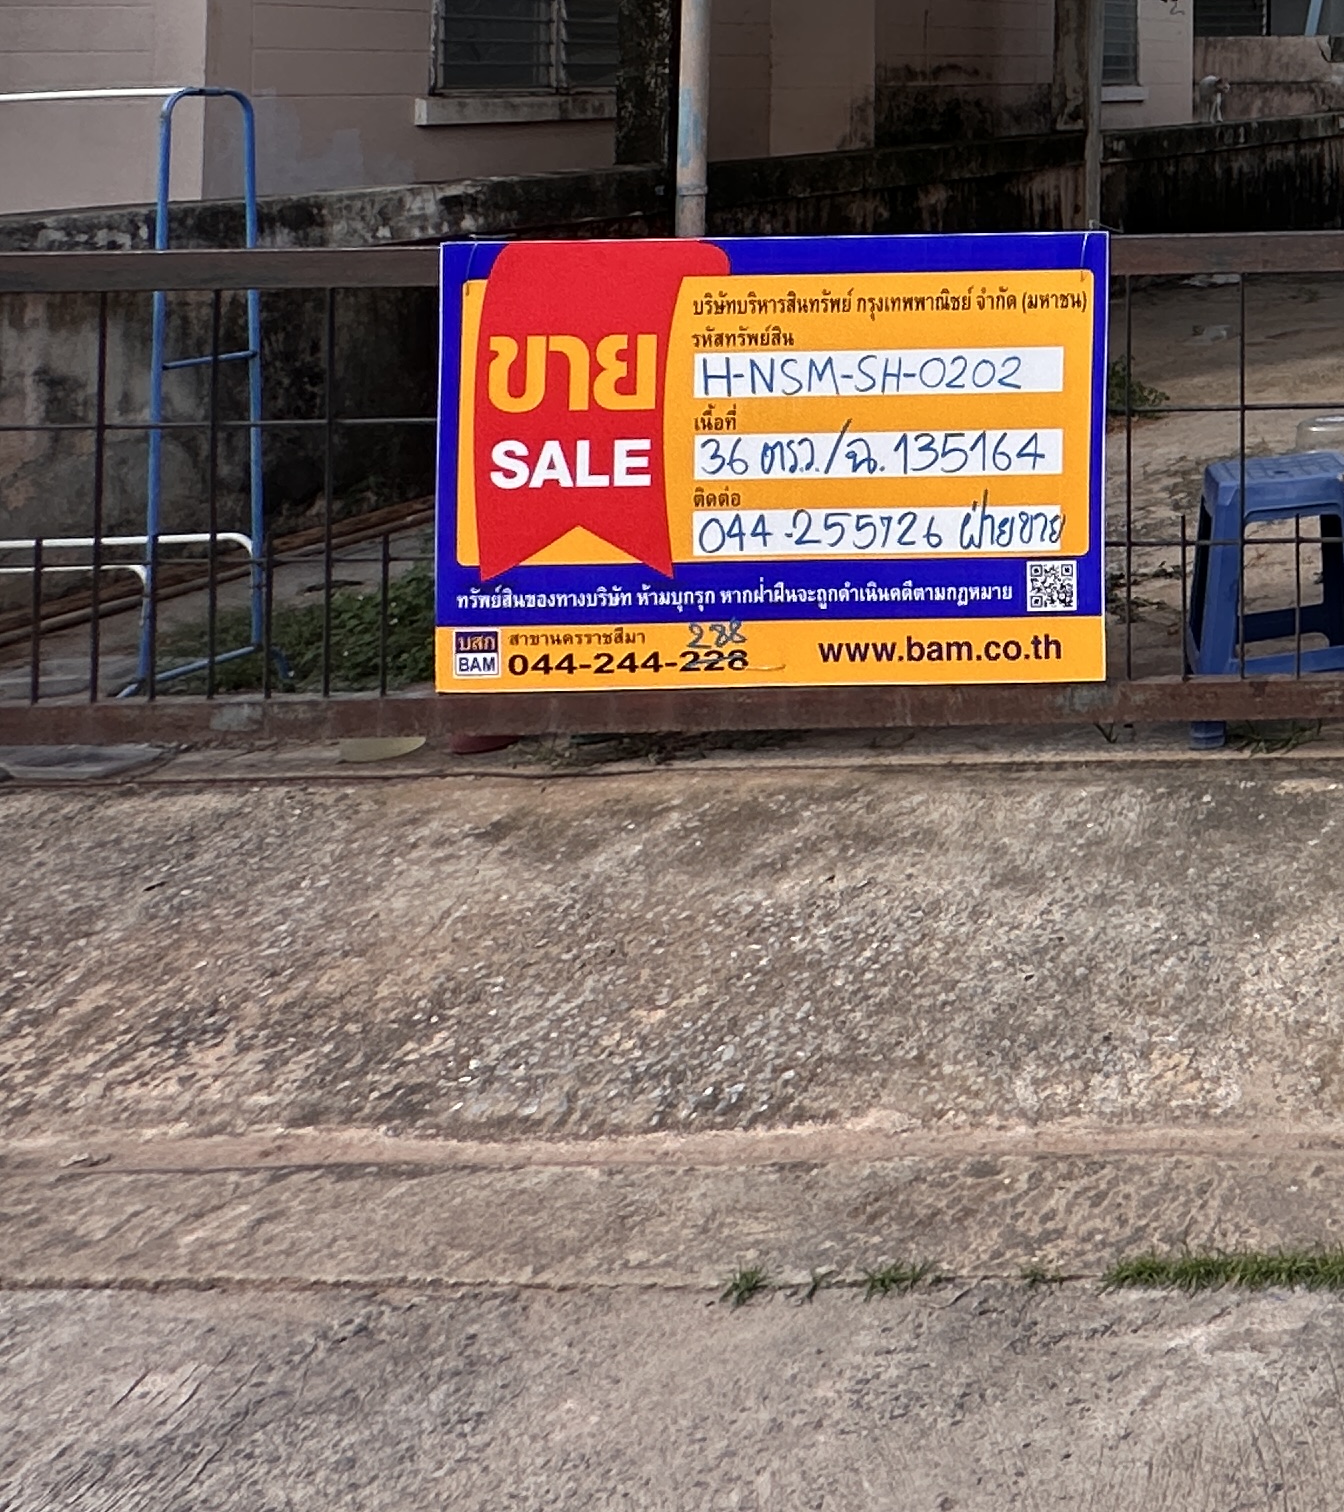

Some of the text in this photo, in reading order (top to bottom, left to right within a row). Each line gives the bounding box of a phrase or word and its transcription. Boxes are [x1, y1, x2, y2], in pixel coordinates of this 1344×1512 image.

[692, 286, 1088, 320] บริษัทบริหารสินทรัพย์ กรุงเทพพาณิชย์ จำกัด (มหาชน)
[691, 325, 794, 348] รหัสทรัพย์สิน
[488, 333, 658, 413] ขาย
[702, 355, 1022, 397] H-NSM-SH-0202
[694, 404, 737, 431] เนื้อที่
[490, 438, 652, 489] SALE
[700, 437, 749, 475] 36
[693, 486, 741, 508] ติดต่อ
[456, 585, 632, 610] ทรัพย์สินของทางบริษัท
[636, 584, 715, 613] ห้ามบุกรุก
[457, 633, 496, 652] บสก
[508, 627, 646, 646] สาขานครราชสีมา
[818, 635, 1062, 663] www.bam.co.th
[458, 655, 496, 673] BAM
[508, 649, 749, 676] 044-244-228
